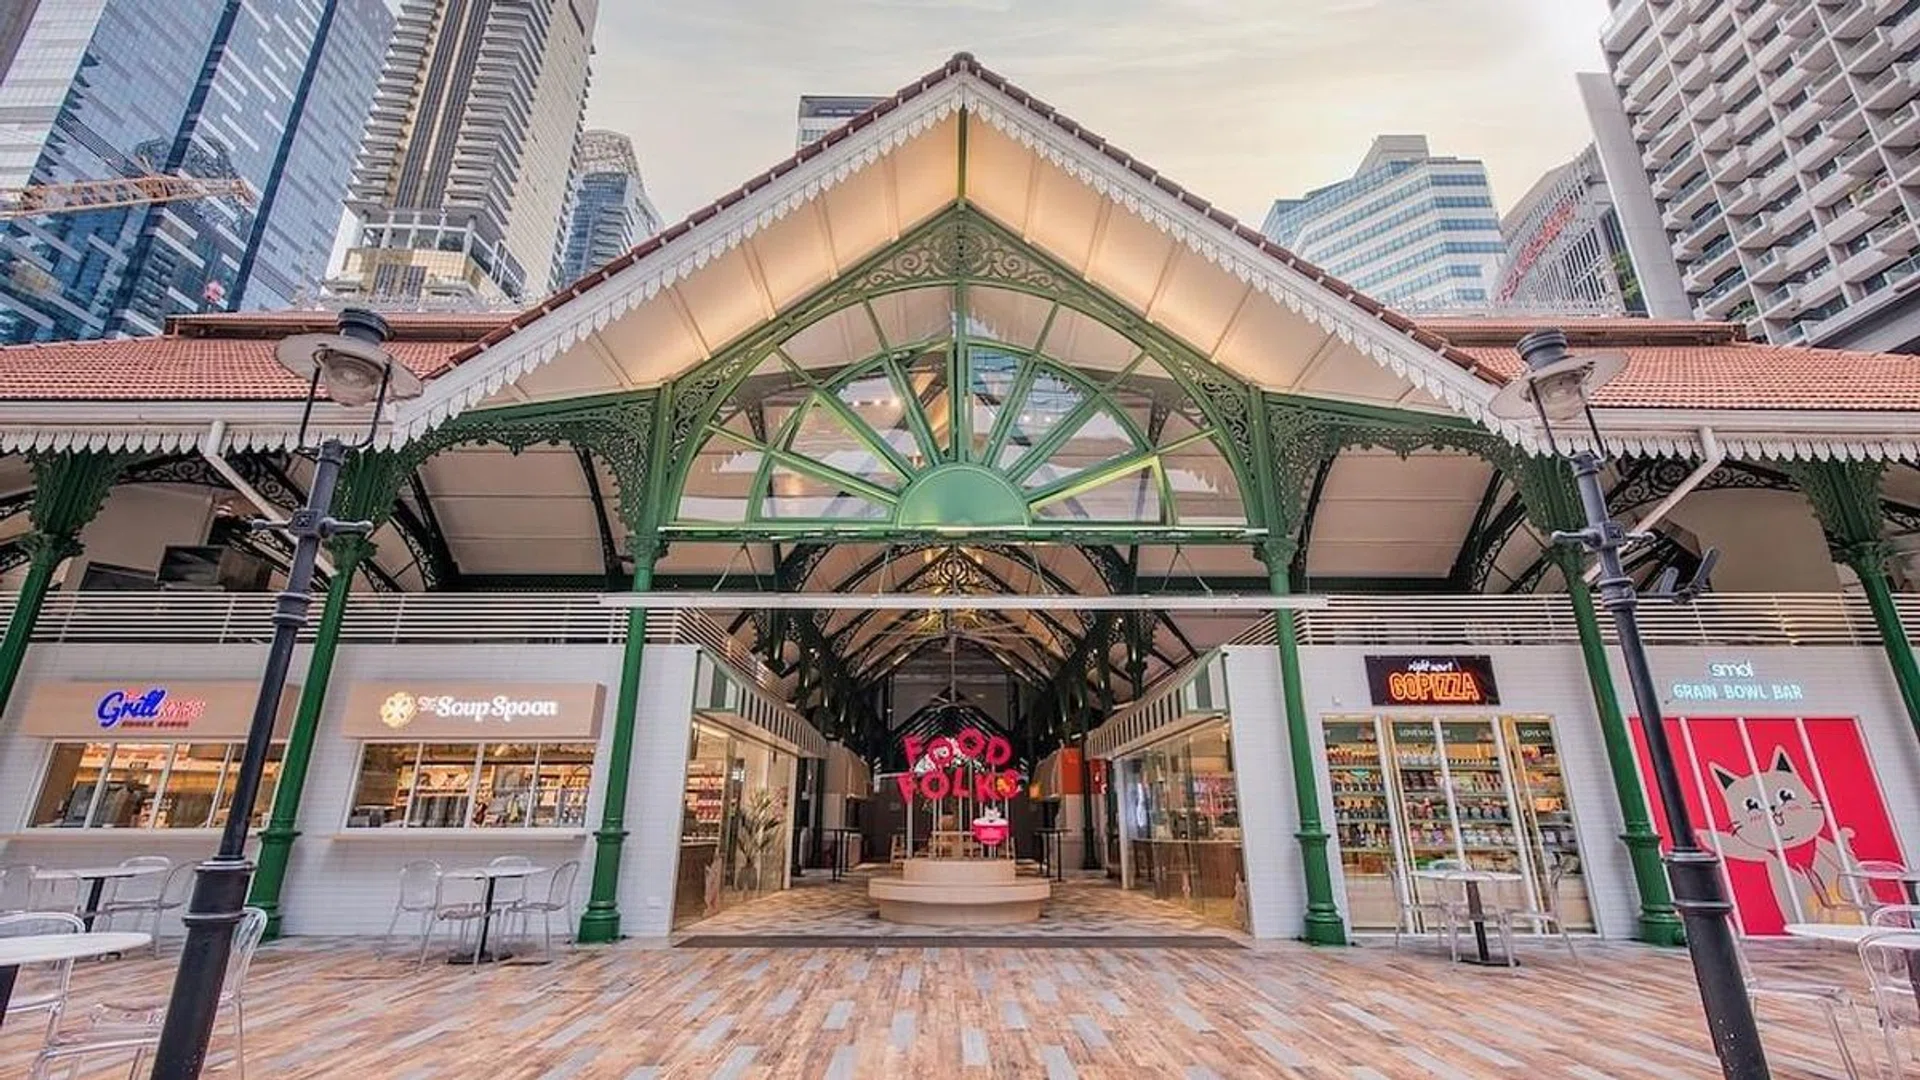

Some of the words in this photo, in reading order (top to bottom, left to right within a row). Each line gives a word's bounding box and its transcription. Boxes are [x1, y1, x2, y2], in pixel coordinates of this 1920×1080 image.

[1711, 660, 1753, 677] smol
[1389, 672, 1480, 700] GOPIZZA
[1673, 684, 1718, 700] GRAIN
[1723, 684, 1768, 699] BOWL
[1772, 684, 1803, 699] BAR
[97, 689, 166, 728] Grill
[436, 695, 490, 722] Soup
[491, 695, 558, 722] Spoon
[902, 726, 1012, 768] FOOD
[896, 768, 1022, 804] FOLKS
